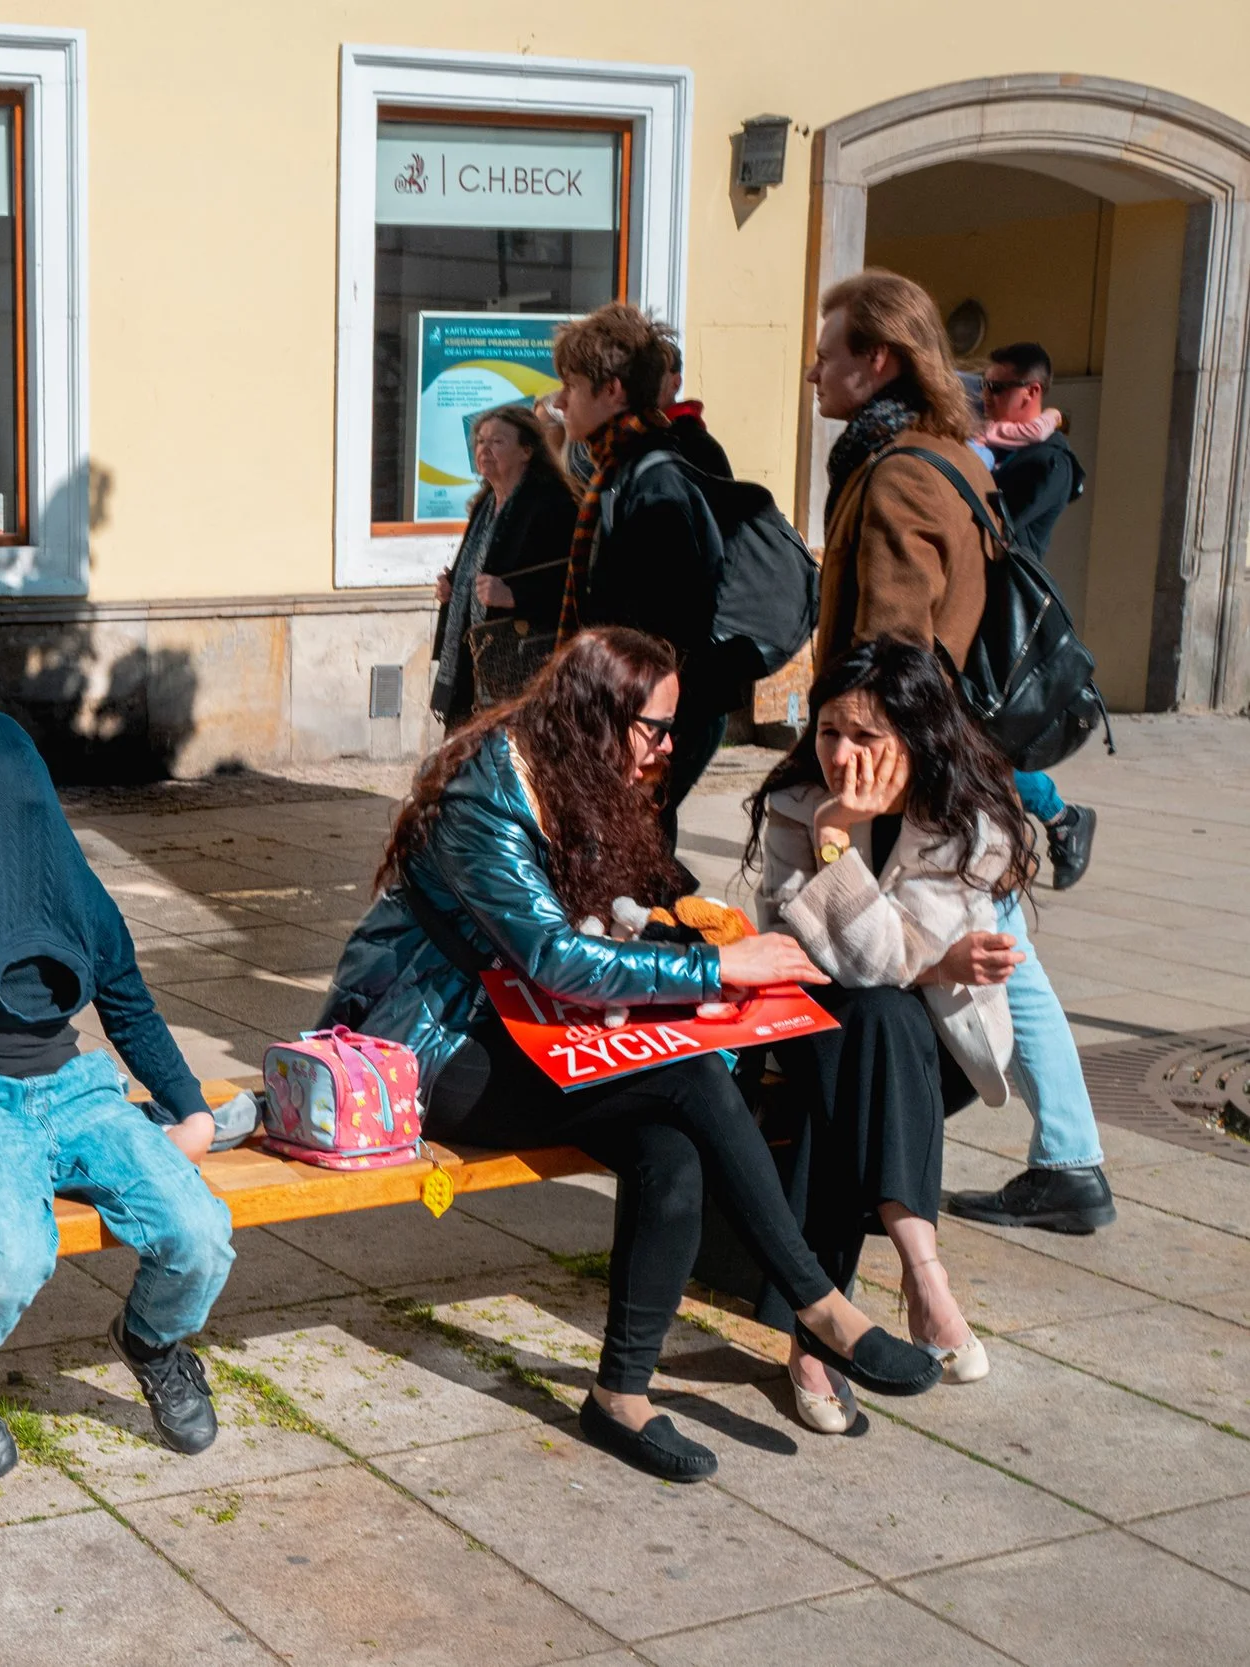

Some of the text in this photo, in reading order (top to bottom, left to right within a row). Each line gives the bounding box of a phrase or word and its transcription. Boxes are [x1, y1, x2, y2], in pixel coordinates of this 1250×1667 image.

[459, 164, 583, 197] C.H.BECK
[444, 327, 521, 338] KARTA PODARUNKOWA
[488, 338, 530, 348] PRAWNICZE
[444, 347, 471, 357] IDEALNY
[474, 348, 502, 358] PREZENT
[503, 349, 514, 358] NA
[548, 1025, 701, 1078] ŻYCIA
